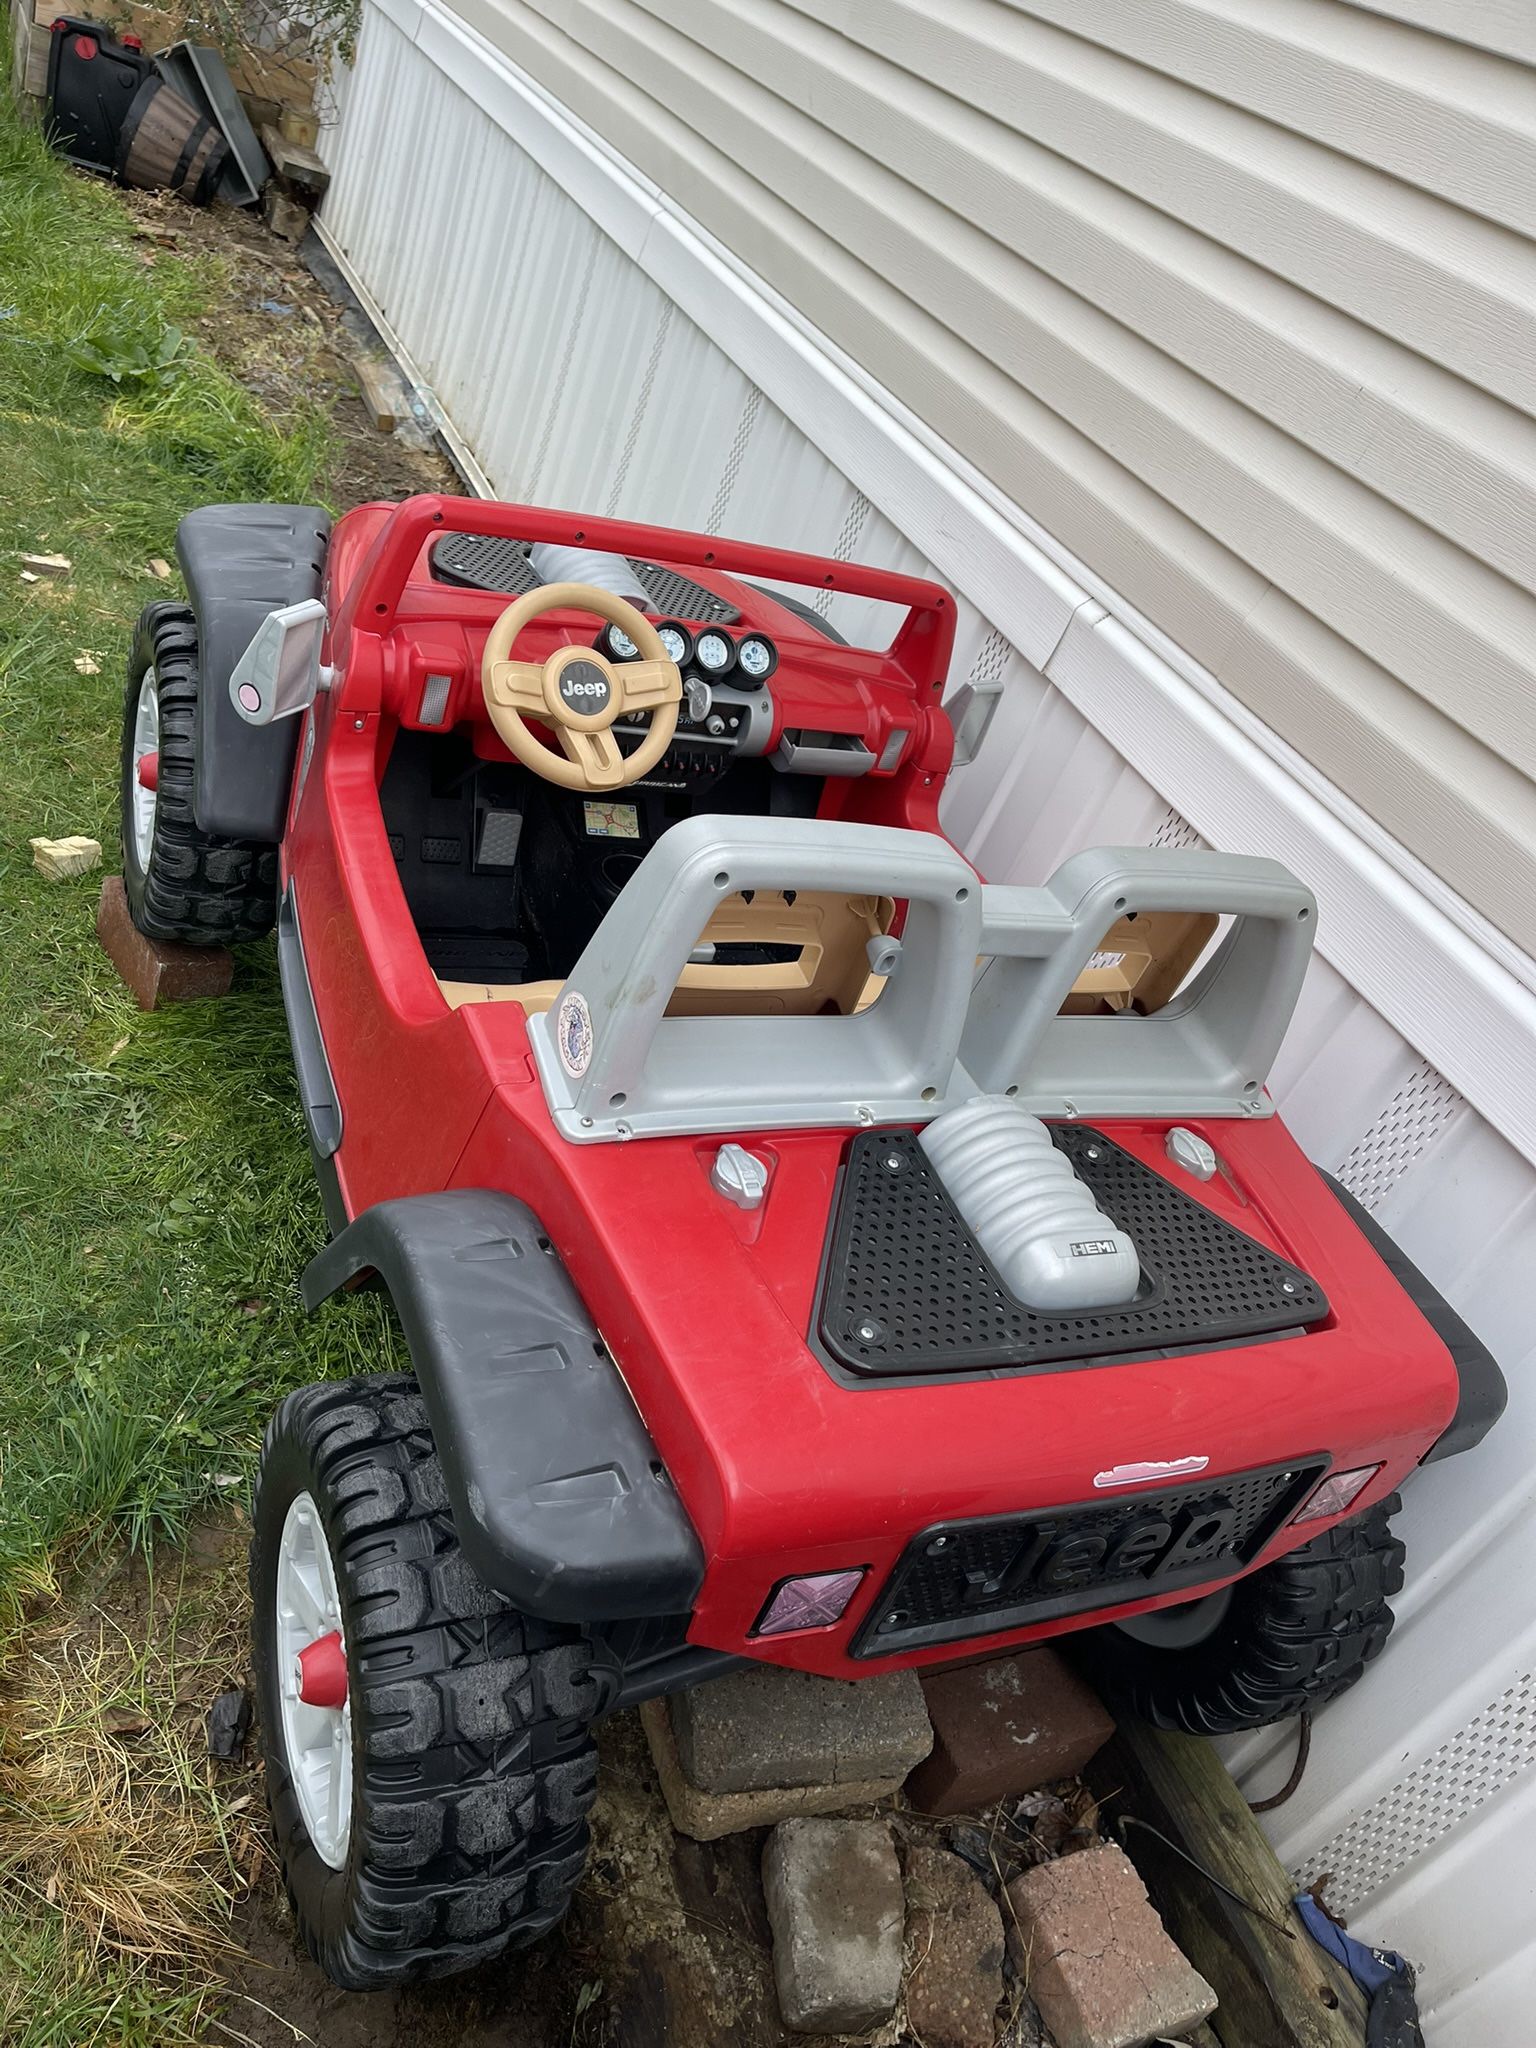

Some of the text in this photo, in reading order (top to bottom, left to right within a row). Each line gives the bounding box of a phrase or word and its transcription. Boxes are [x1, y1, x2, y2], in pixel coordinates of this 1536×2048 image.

[562, 680, 607, 698] Jeep
[1070, 1241, 1117, 1257] HEMI
[965, 1495, 1236, 1600] Jeep
